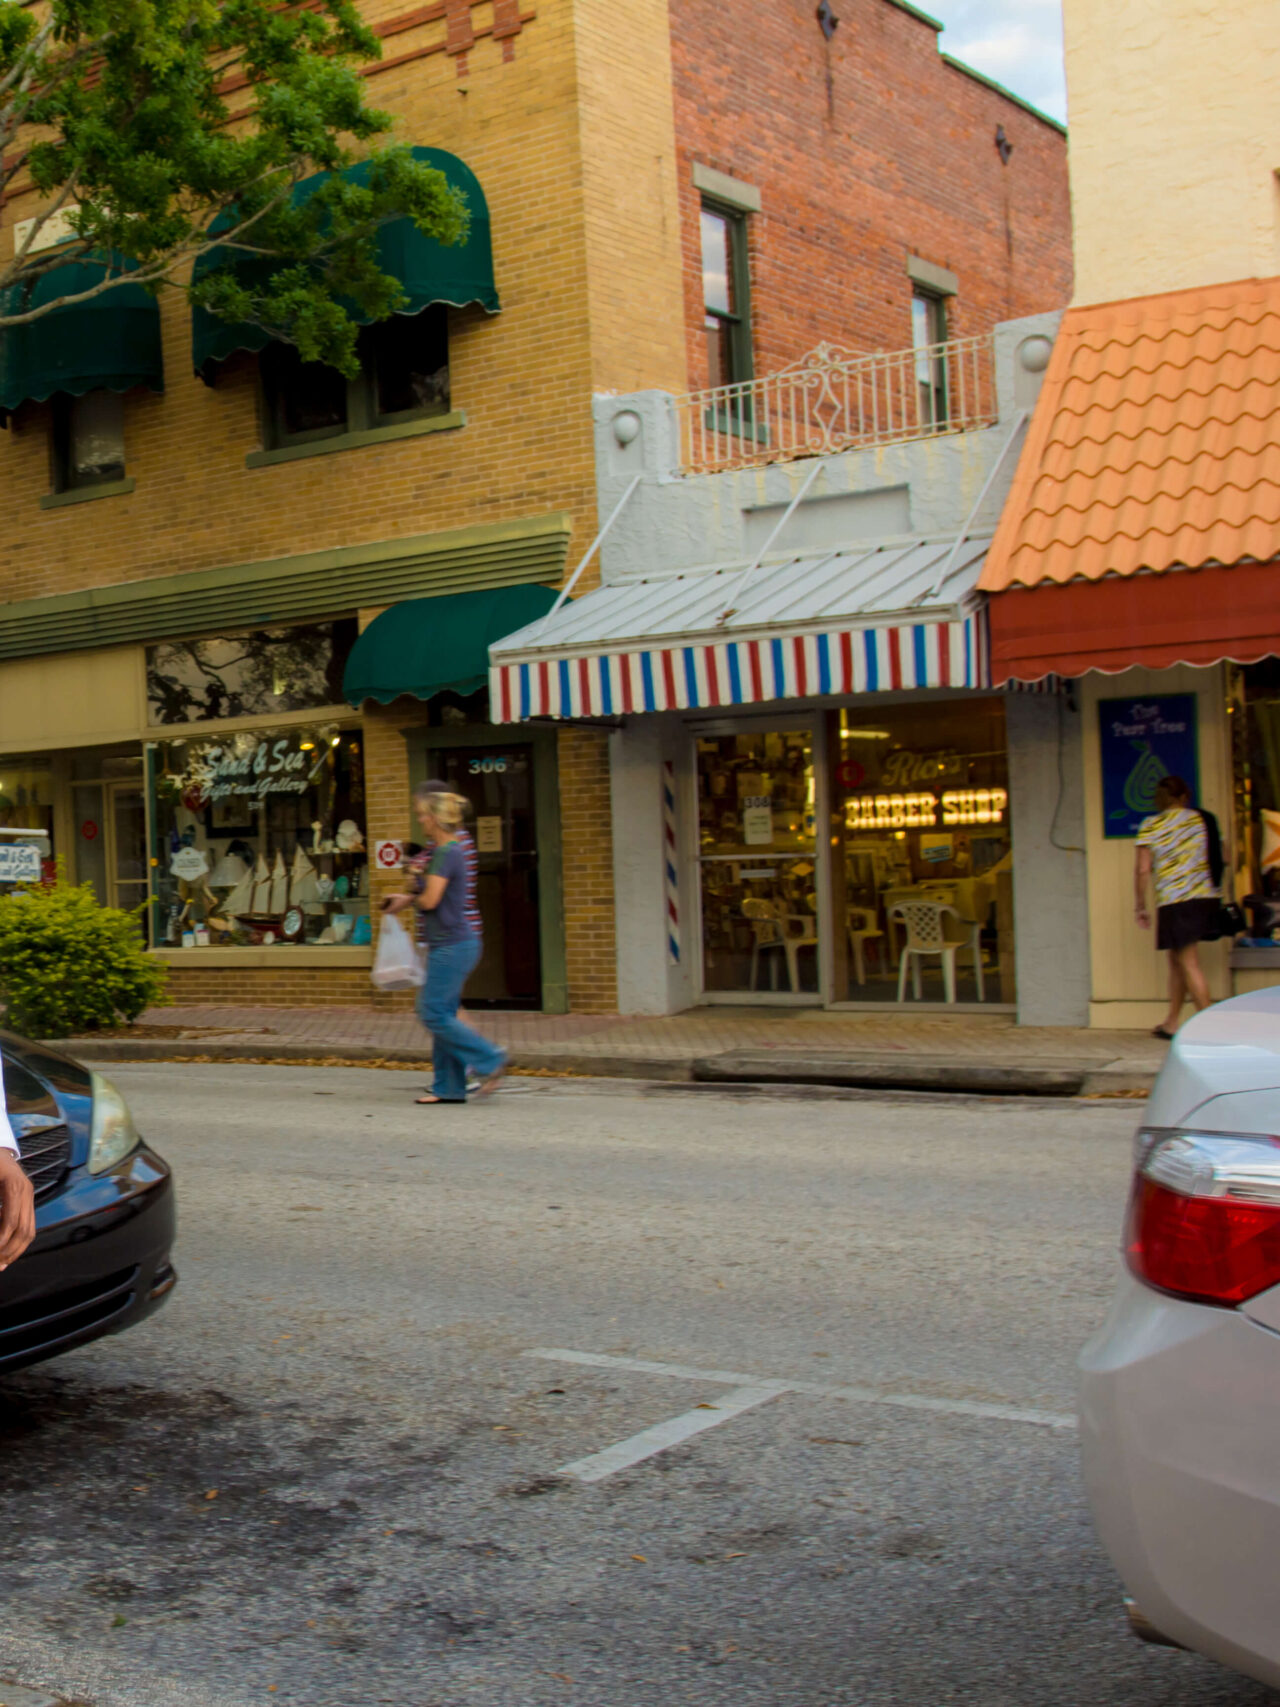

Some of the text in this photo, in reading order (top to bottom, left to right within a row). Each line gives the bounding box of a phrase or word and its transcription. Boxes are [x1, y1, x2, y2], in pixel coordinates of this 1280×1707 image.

[205, 740, 305, 778] Sand & Sea
[468, 757, 508, 775] 306
[258, 777, 308, 799] Gallery
[845, 787, 1008, 830] BARBER SHOP
